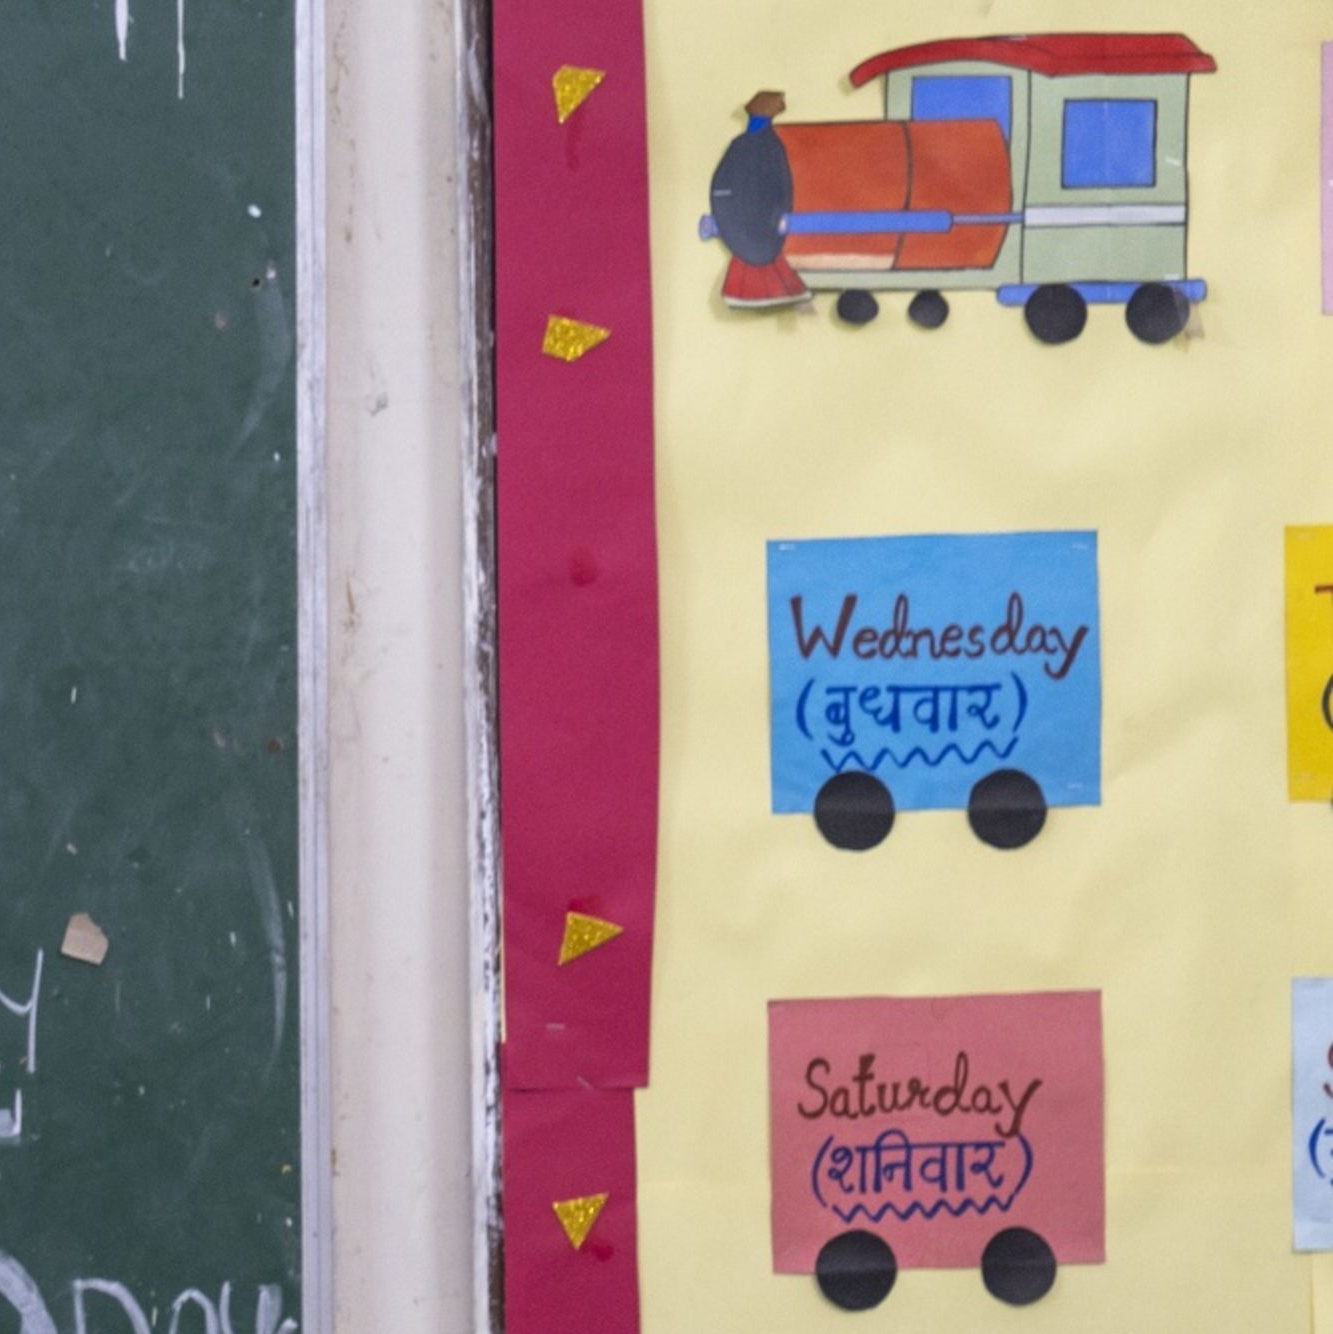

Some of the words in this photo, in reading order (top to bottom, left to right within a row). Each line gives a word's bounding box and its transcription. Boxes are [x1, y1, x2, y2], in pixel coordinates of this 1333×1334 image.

[790, 592, 1090, 681] Wednesday
[795, 671, 1028, 746] (बुधवार)
[797, 1050, 1043, 1138] Saturday
[810, 1127, 1034, 1206] (शनिवार)
